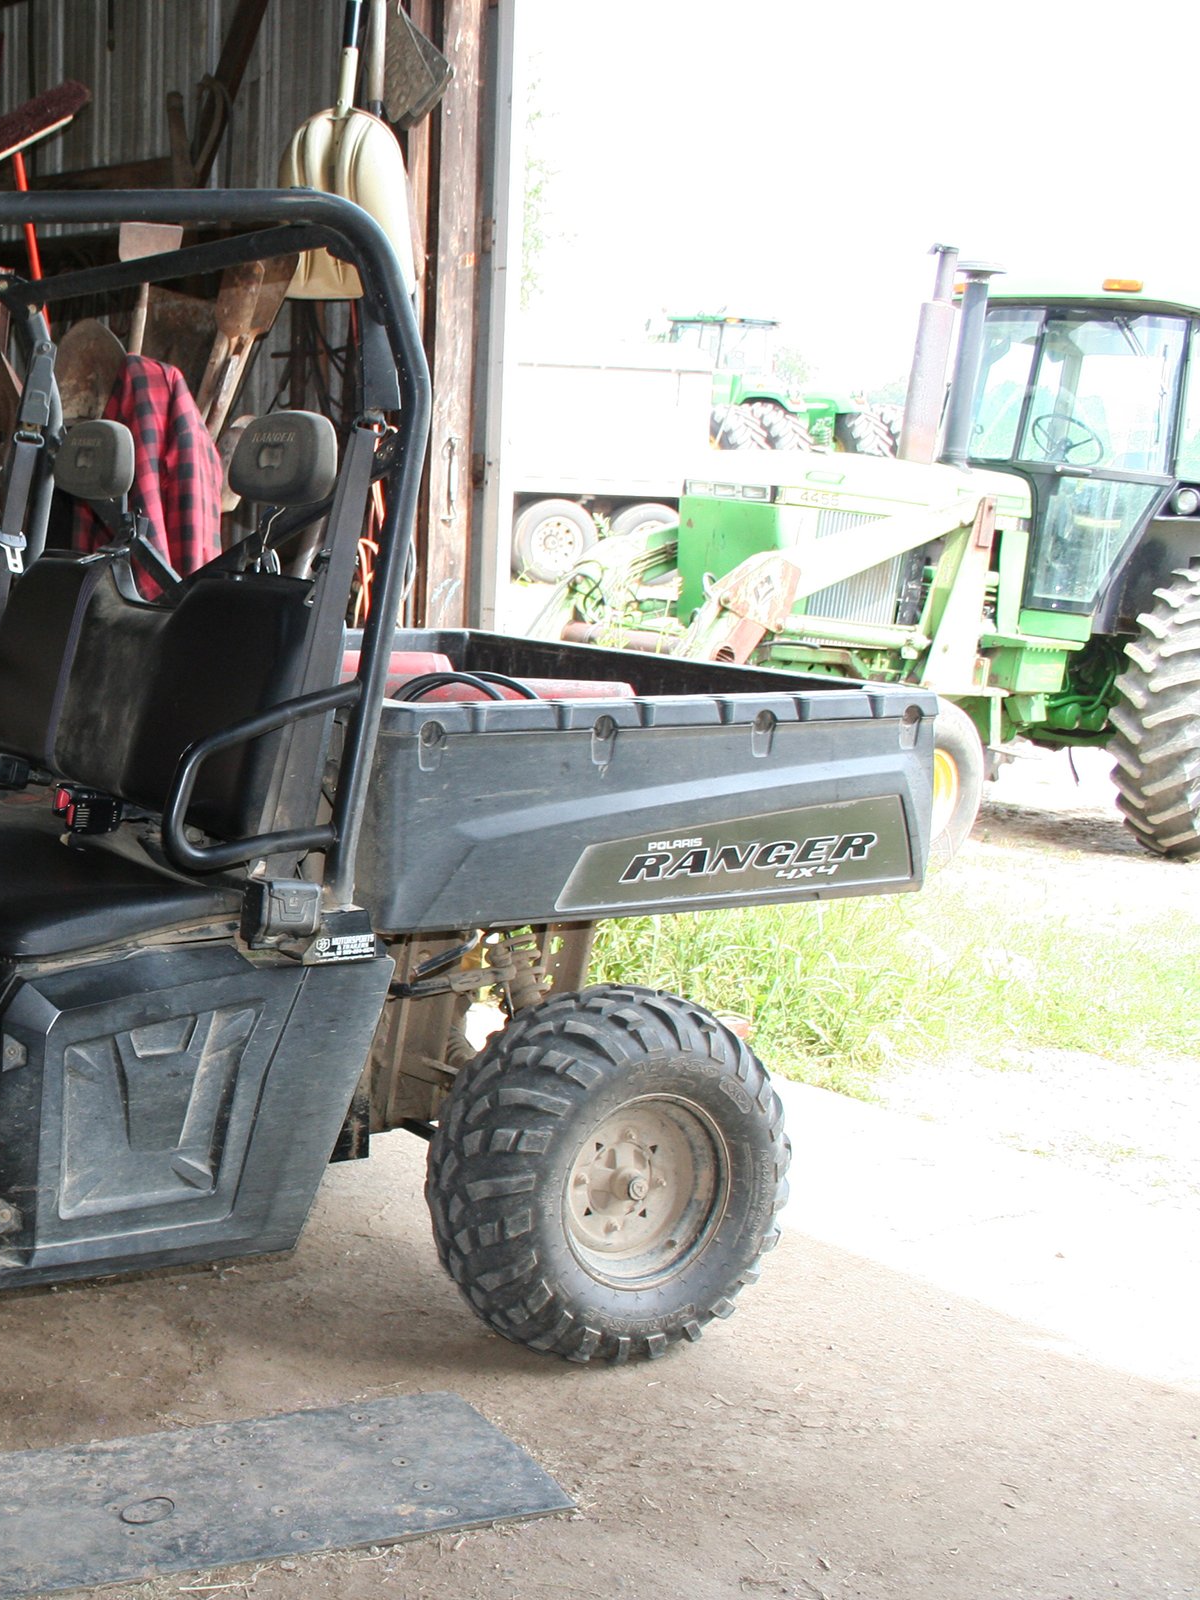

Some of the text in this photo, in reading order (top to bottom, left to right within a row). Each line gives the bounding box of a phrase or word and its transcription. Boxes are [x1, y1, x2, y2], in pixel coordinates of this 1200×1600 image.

[800, 491, 839, 506] 4455
[648, 837, 703, 851] POLARIS
[618, 832, 878, 884] RANGER
[331, 934, 375, 946] MOTORSPORTS
[584, 1303, 696, 1333] CARLISLE
